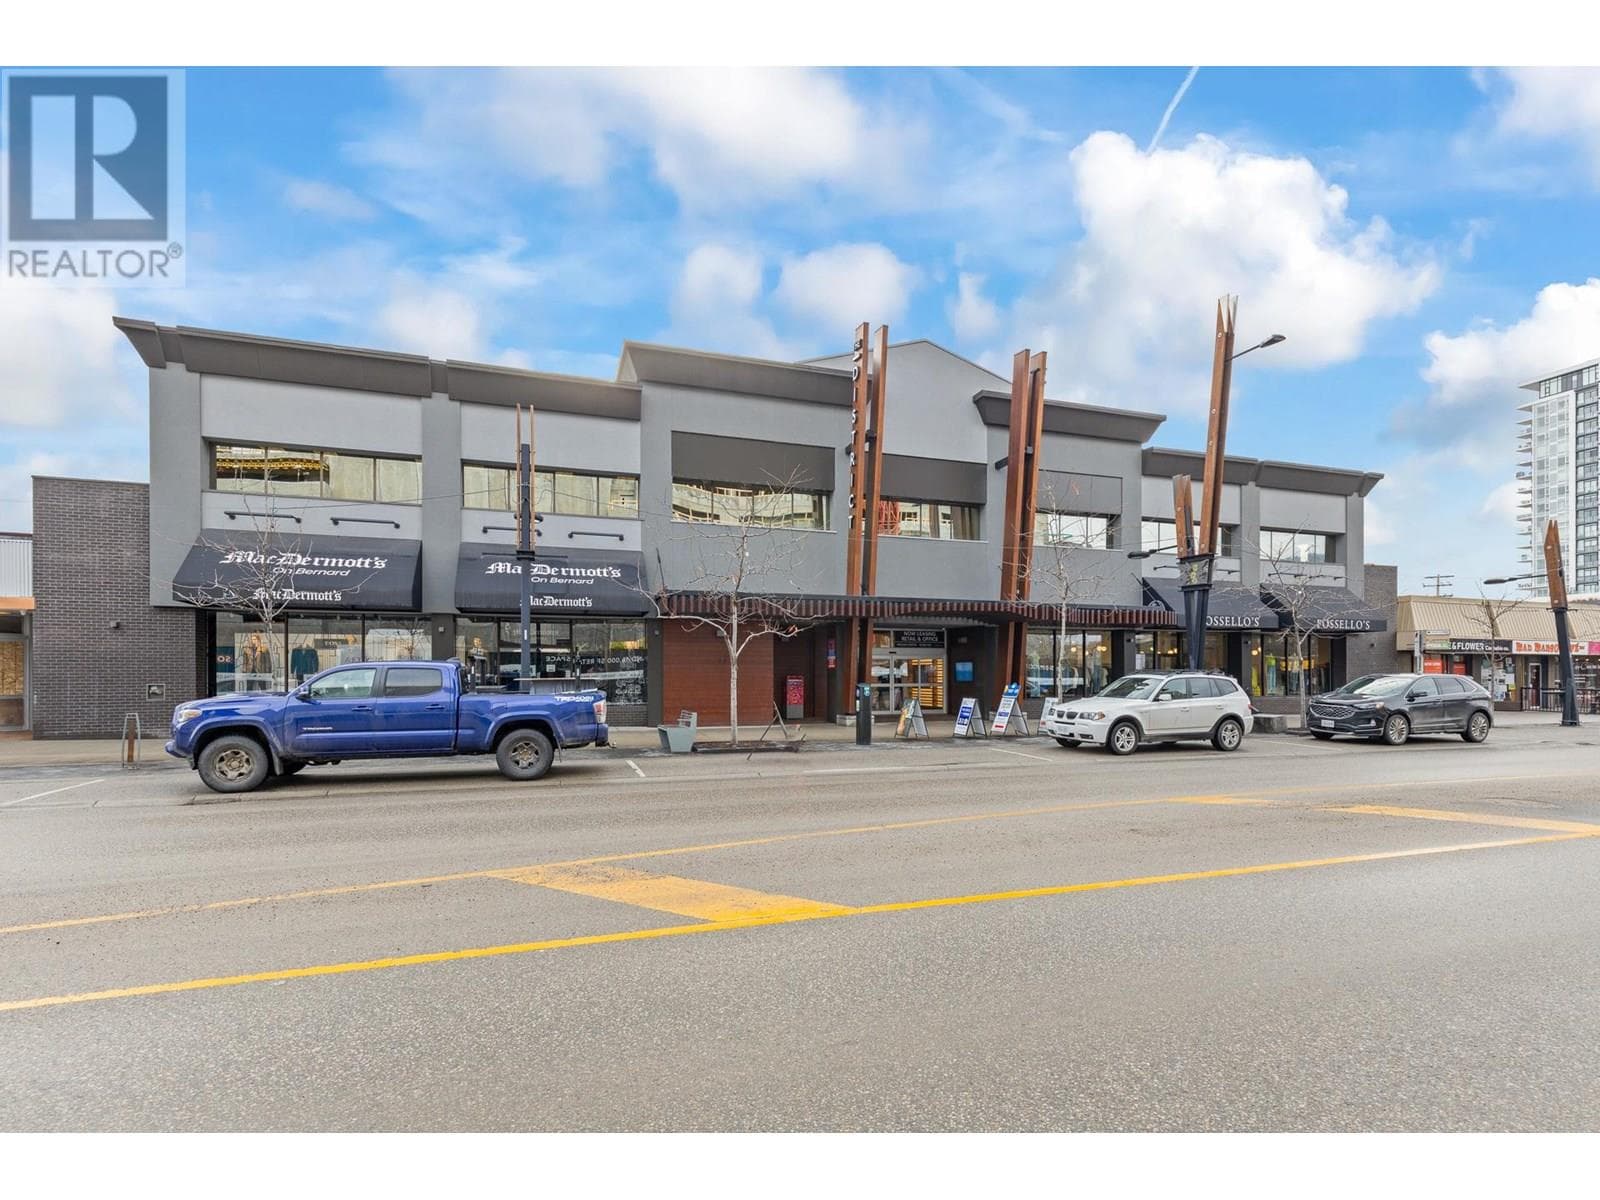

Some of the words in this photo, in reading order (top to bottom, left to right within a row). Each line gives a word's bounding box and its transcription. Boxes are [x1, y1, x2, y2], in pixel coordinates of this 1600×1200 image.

[219, 550, 388, 570] MacDermott's
[272, 567, 292, 575] On
[294, 567, 351, 577] Bernard
[485, 561, 622, 578] MaDermott's
[531, 576, 548, 584] On
[550, 576, 594, 585] Bernard
[520, 595, 593, 608] acDermott's
[1206, 615, 1261, 628] OSSELLO'S
[1457, 642, 1484, 650] FLOWER
